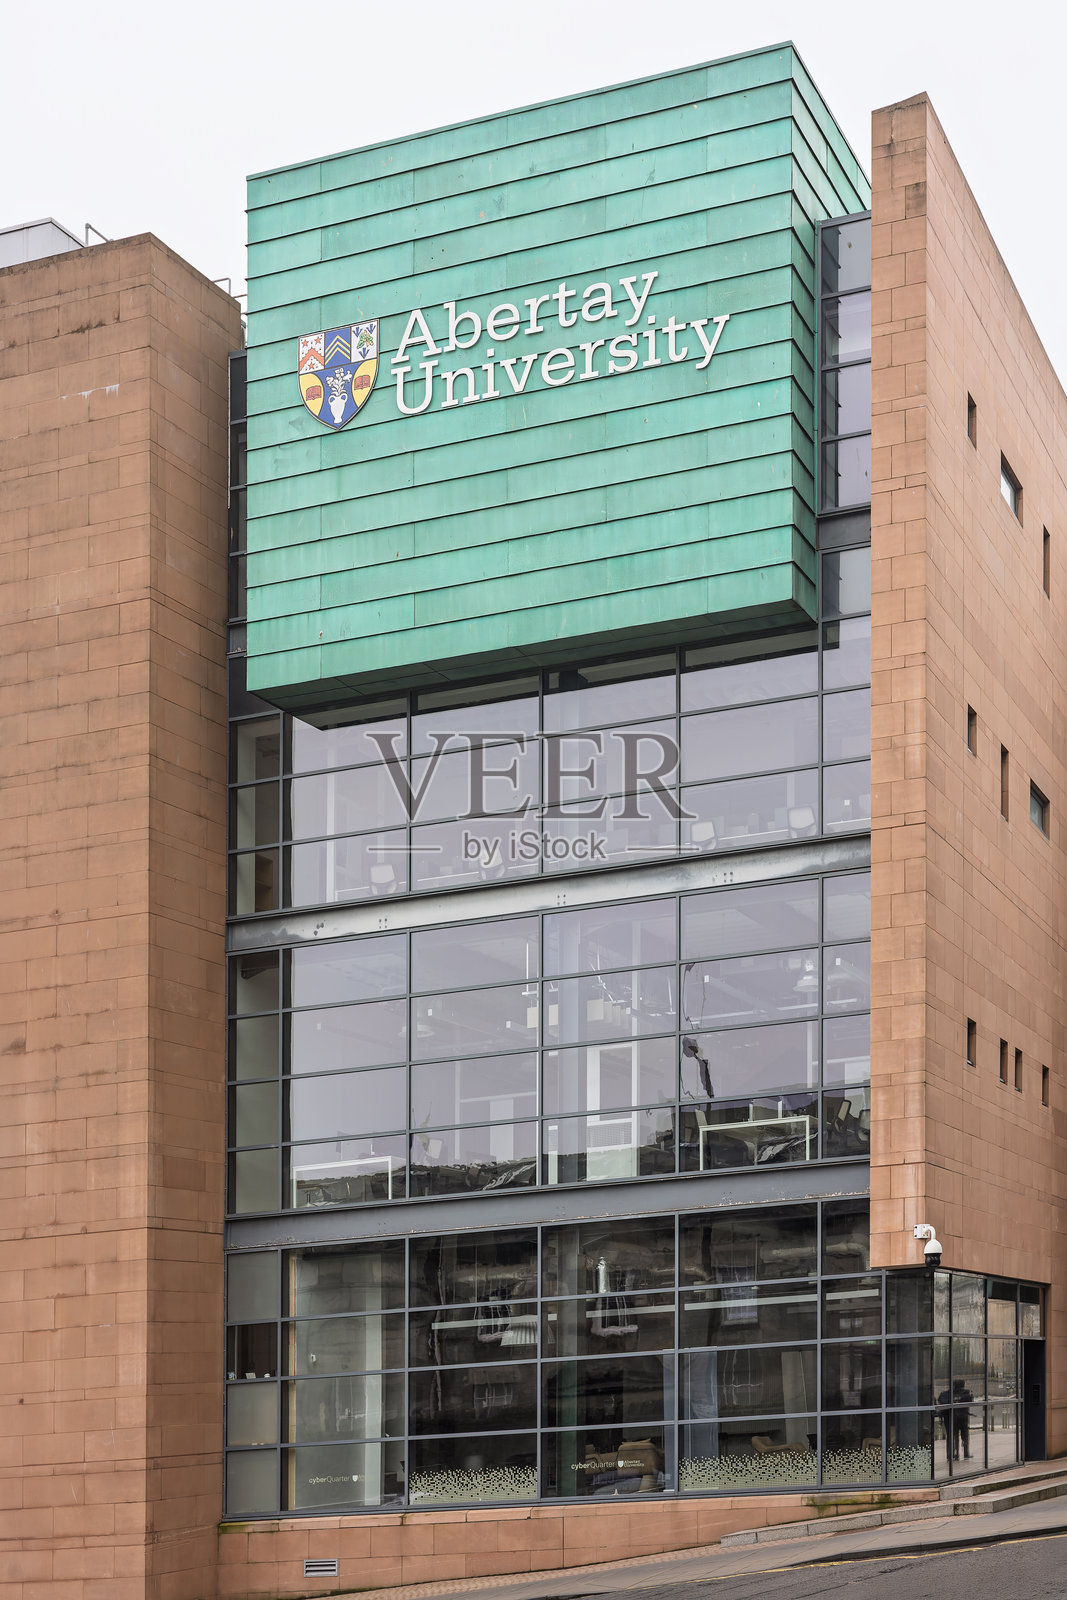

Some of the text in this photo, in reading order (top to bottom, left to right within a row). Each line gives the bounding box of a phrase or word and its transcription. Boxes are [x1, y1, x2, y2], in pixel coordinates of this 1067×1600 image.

[391, 271, 658, 364] Abertay
[391, 314, 730, 415] University
[570, 1461, 616, 1471] cyberQuarter
